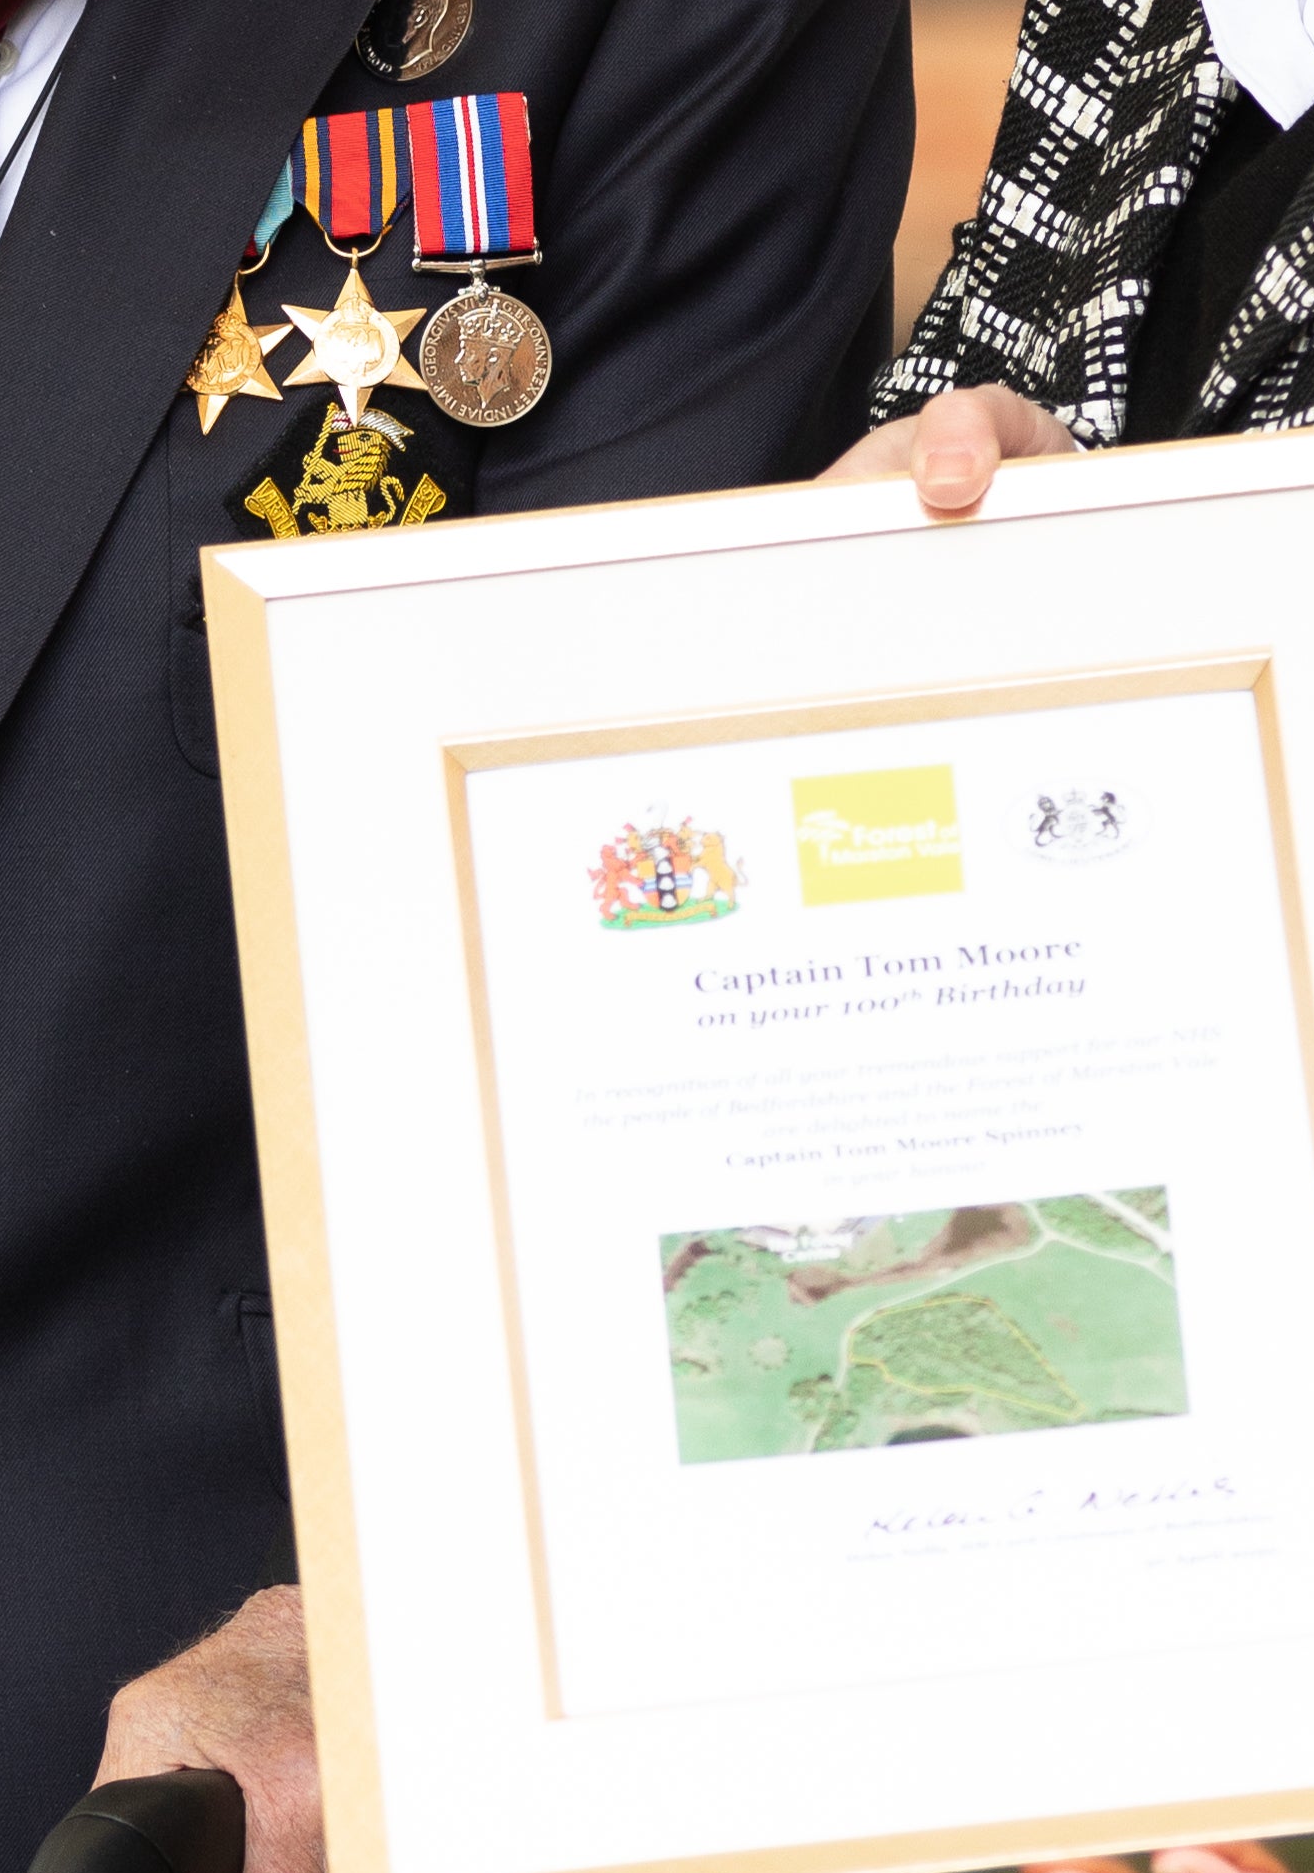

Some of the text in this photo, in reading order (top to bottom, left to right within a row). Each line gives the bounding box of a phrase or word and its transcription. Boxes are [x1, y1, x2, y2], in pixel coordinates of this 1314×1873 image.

[853, 819, 936, 846] Forest
[692, 939, 1084, 996] Captain Tom Moore
[696, 974, 1086, 1030] on your 100th Birthday
[605, 1077, 730, 1101] recognition
[1172, 1025, 1222, 1043] NHS
[728, 1091, 869, 1116] Bedfordshire
[725, 1120, 1084, 1169] Captain Tom Moore Spinney
